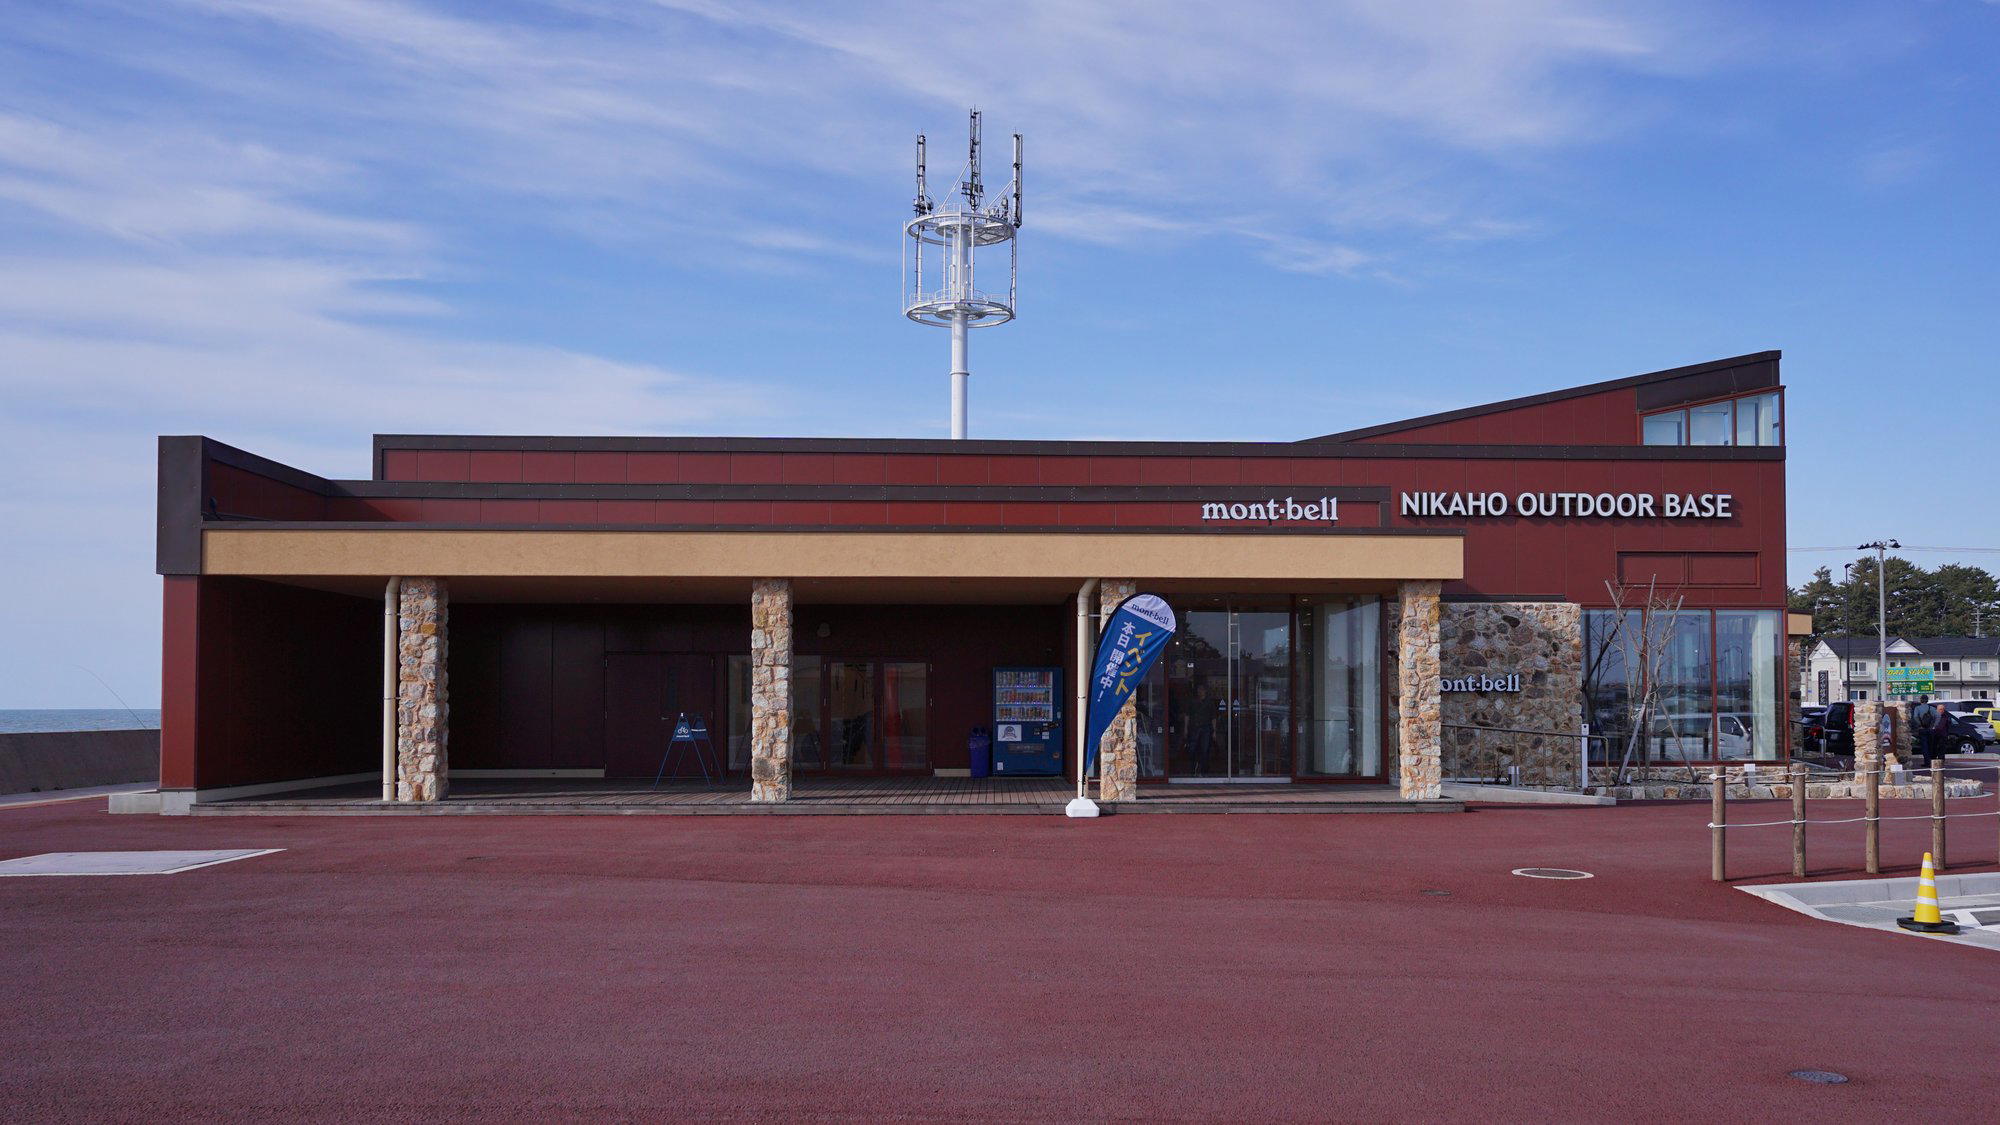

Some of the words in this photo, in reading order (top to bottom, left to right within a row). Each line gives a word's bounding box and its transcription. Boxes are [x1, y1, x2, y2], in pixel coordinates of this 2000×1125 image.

[1401, 492, 1508, 517] NIKAHO
[1516, 492, 1656, 517] OUTDOOR
[1663, 493, 1732, 518] BASE
[1115, 631, 1152, 695] イベント
[1440, 673, 1521, 692] ont·bell
